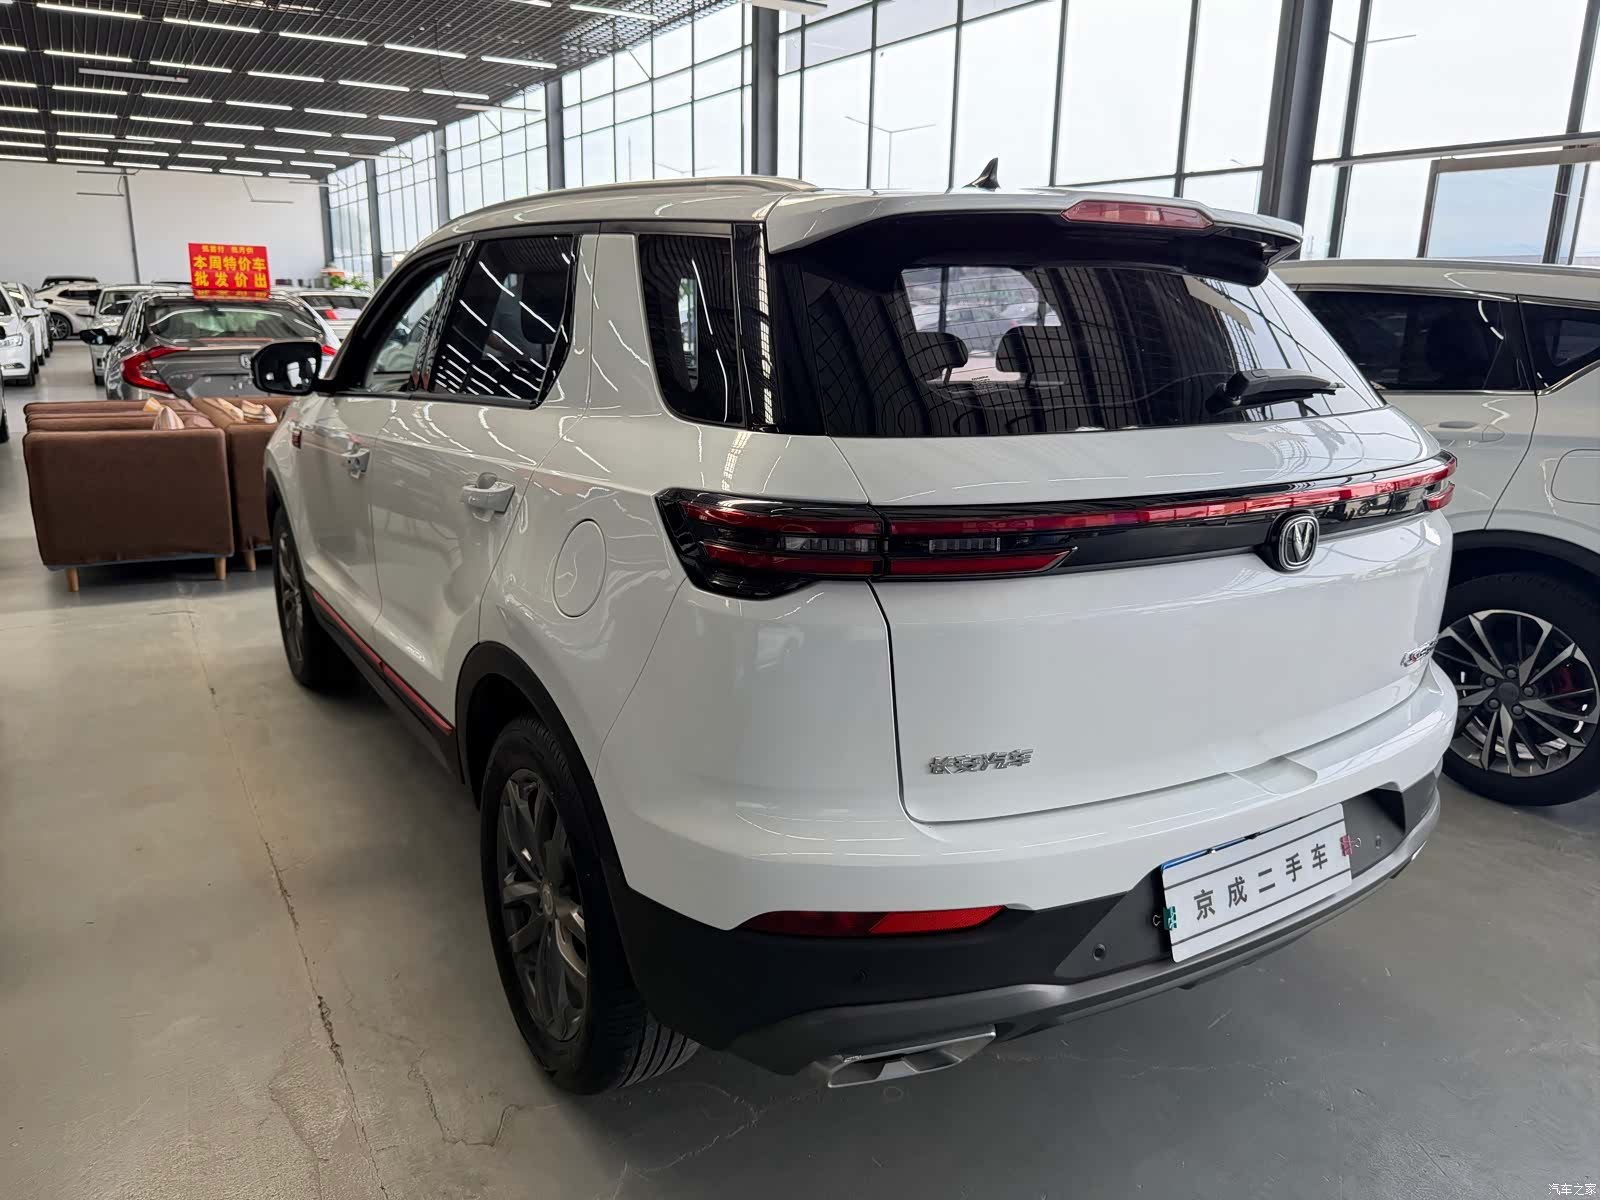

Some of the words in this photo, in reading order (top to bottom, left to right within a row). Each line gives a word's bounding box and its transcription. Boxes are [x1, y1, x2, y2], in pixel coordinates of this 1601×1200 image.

[193, 254, 267, 272] 本周特价车
[194, 270, 268, 289] 批发价出
[927, 748, 1034, 775] 长安汽车
[1193, 842, 1328, 921] 京成二手车
